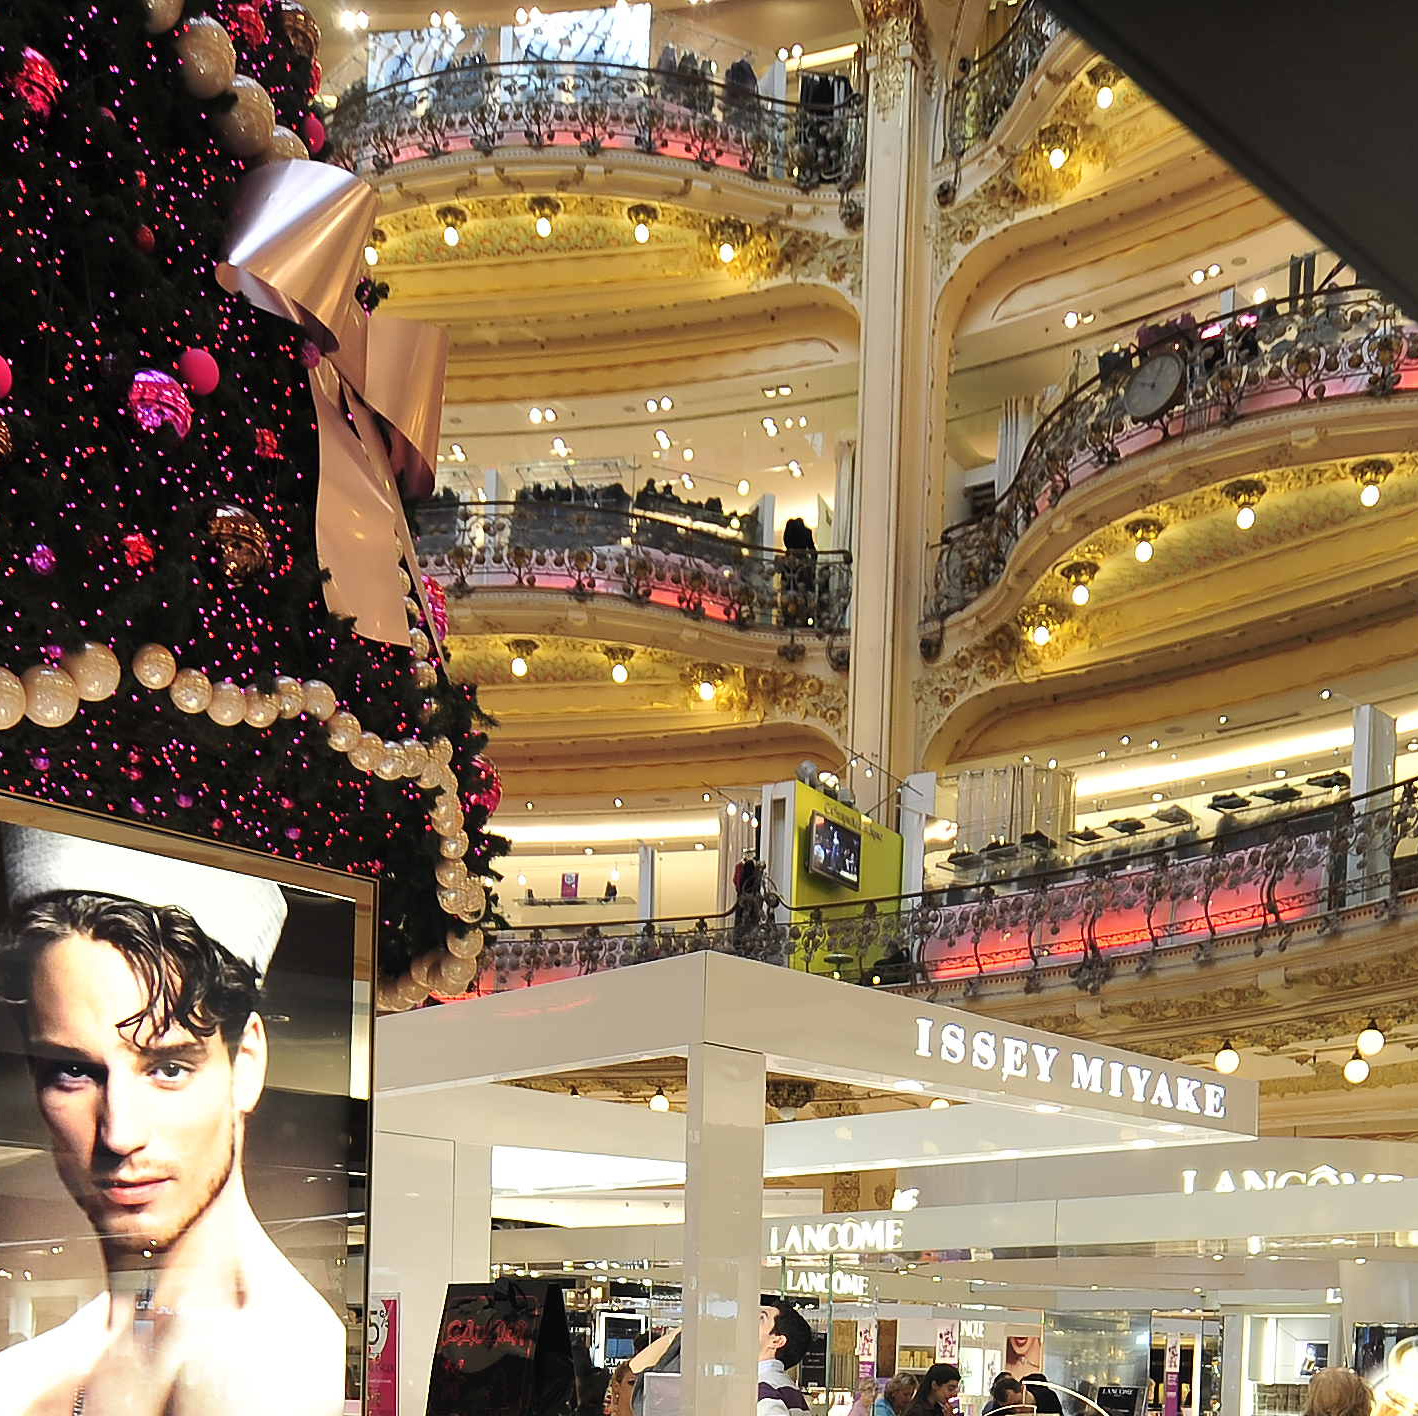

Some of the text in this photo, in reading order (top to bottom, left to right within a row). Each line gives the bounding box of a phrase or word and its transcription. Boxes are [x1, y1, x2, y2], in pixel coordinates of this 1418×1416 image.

[914, 1016, 1227, 1119] ISSEY MIYAKE
[769, 1216, 904, 1253] LANCÔME
[785, 1269, 870, 1297] LANCÔME
